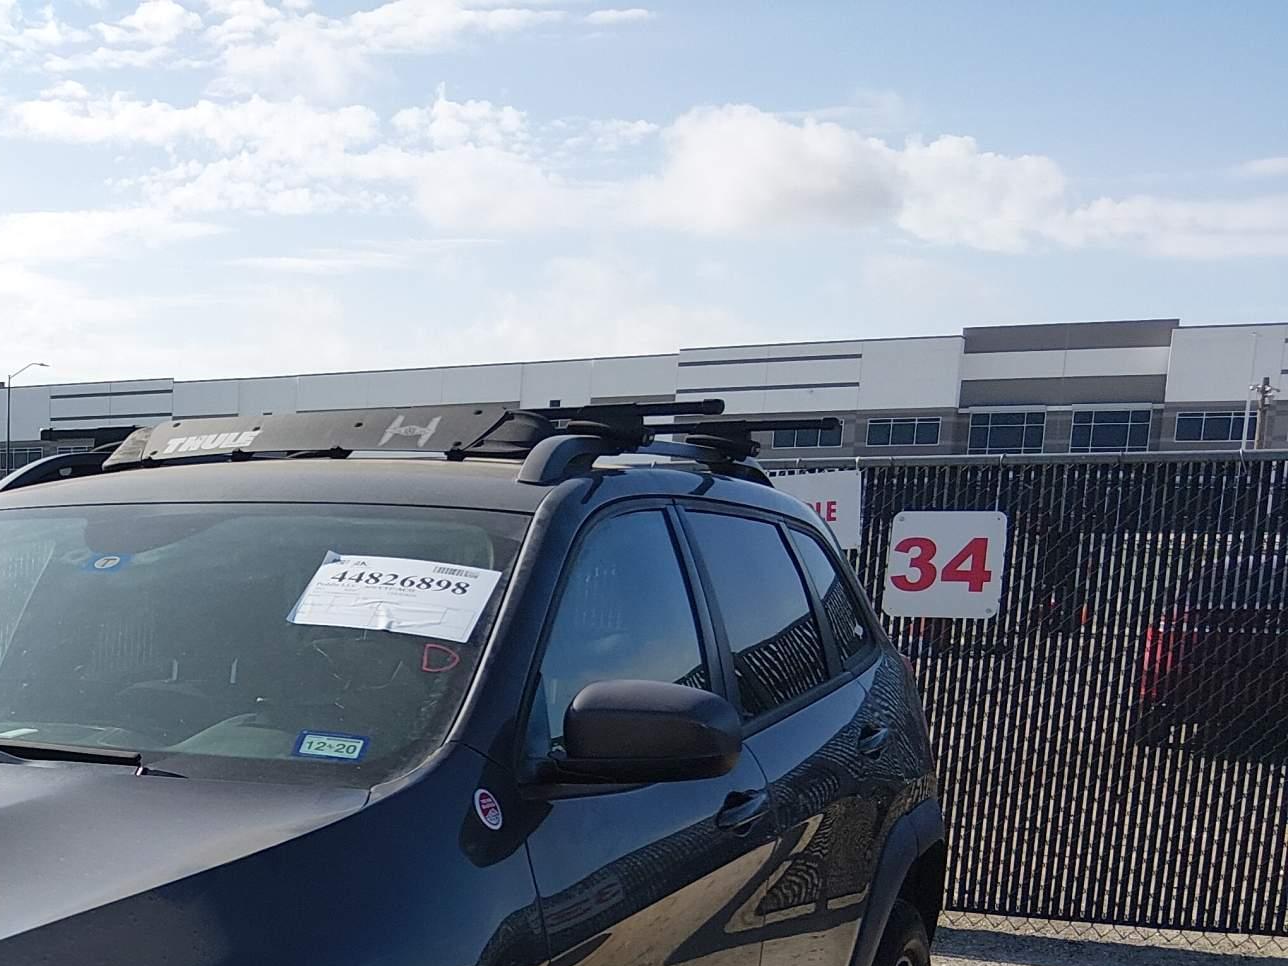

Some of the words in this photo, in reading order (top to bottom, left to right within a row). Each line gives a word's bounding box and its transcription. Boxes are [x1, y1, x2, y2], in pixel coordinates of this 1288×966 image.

[163, 430, 262, 453] THULE
[890, 537, 992, 593] 34
[330, 570, 471, 596] 44826898
[421, 643, 460, 672] D
